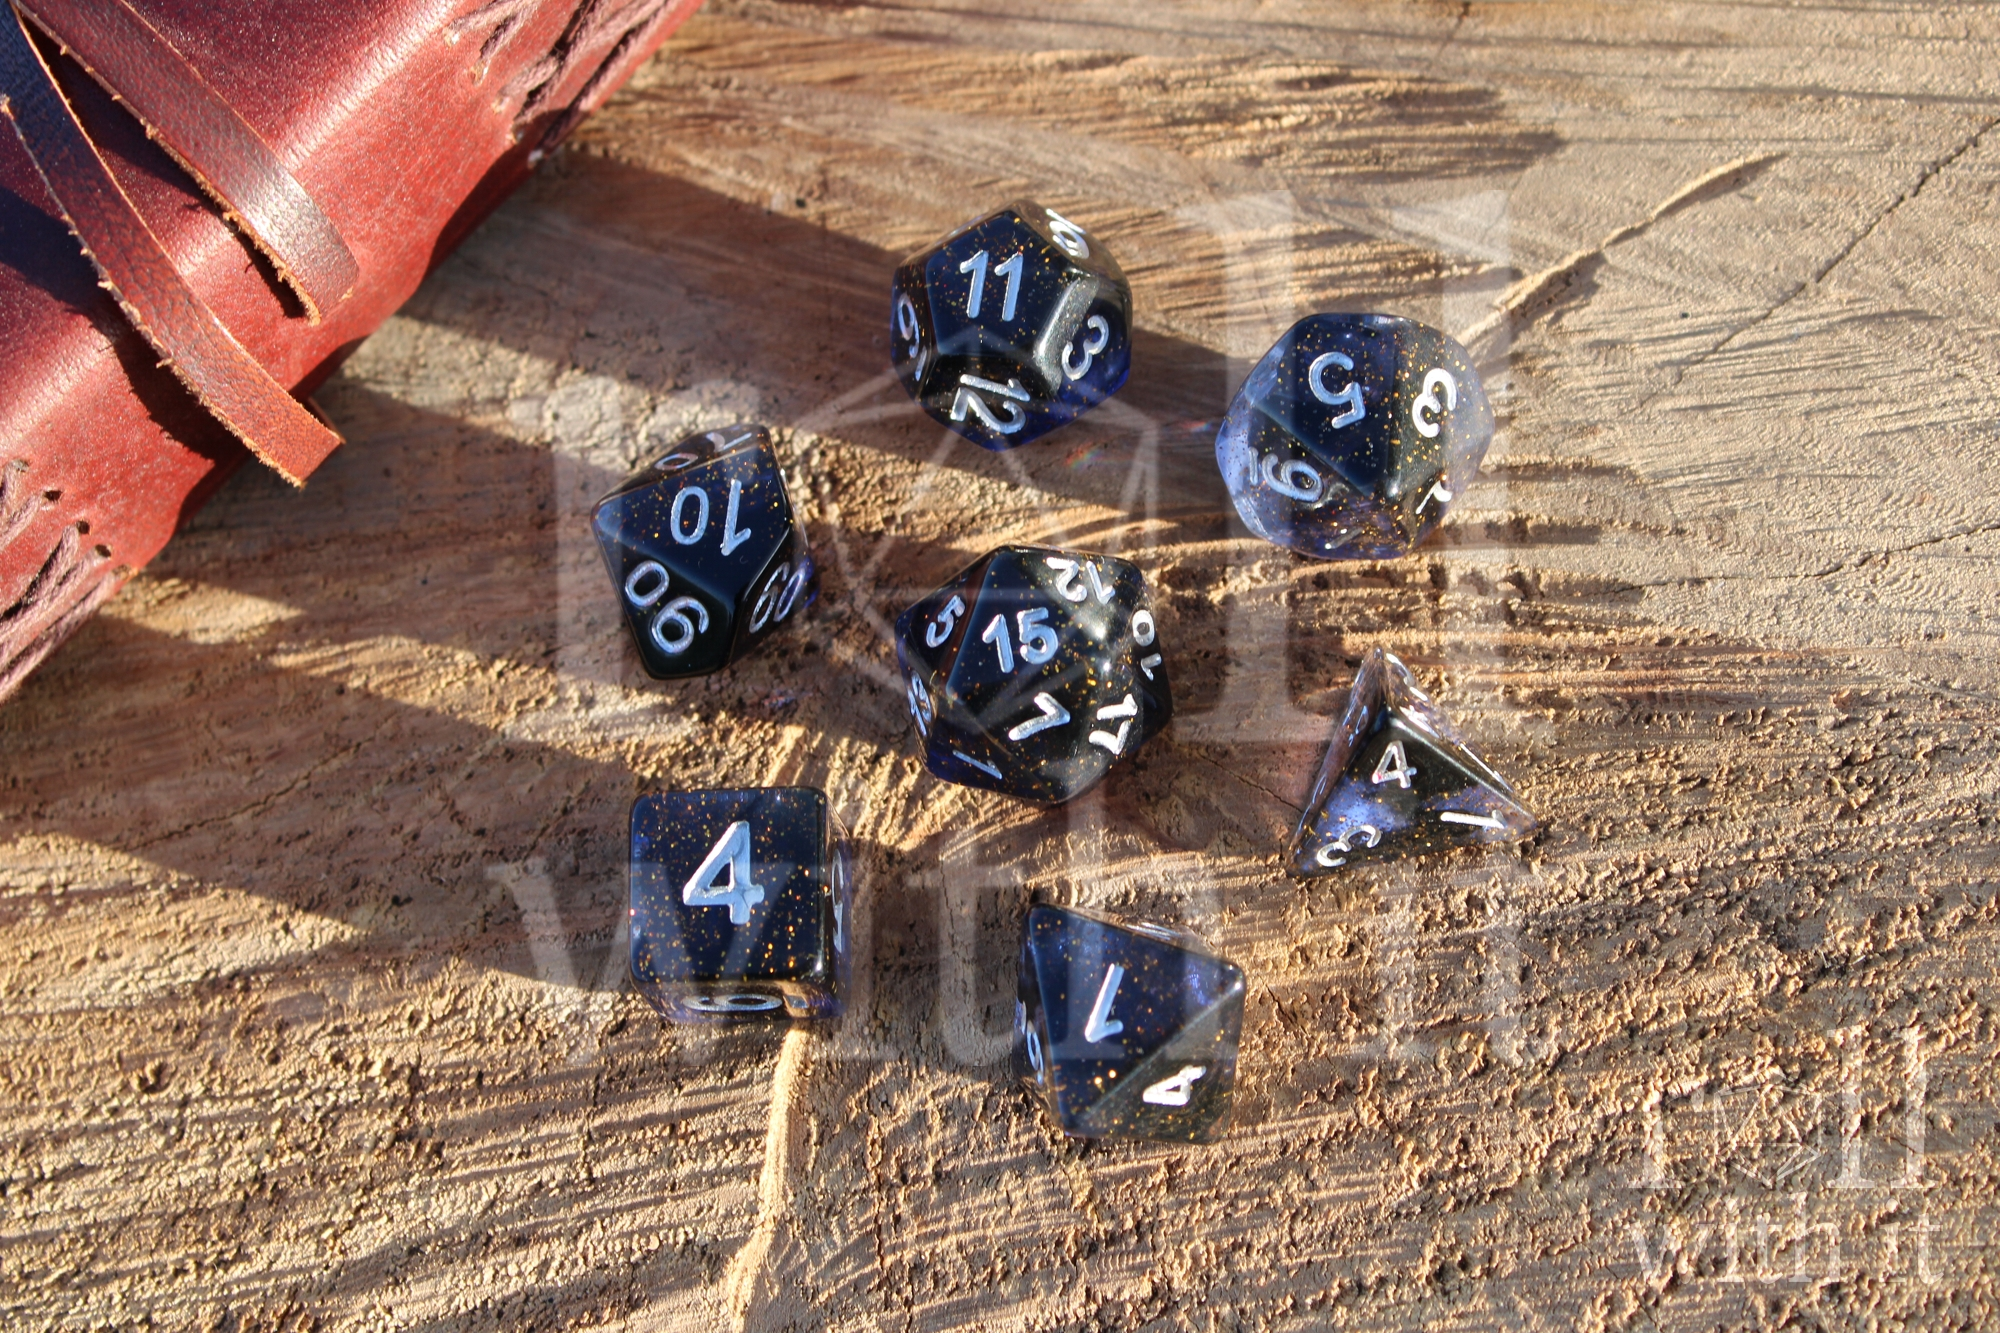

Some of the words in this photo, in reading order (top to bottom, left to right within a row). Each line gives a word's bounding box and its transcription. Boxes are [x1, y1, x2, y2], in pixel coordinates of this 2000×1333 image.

[960, 250, 1024, 322] 11
[1061, 314, 1110, 381] 3
[950, 373, 1031, 434] 12
[1308, 351, 1366, 429] 5
[1411, 367, 1457, 438] 3
[670, 478, 752, 556] 10
[1046, 556, 1116, 605] 12
[925, 593, 966, 649] 5
[982, 606, 1059, 673] 15
[1088, 692, 1139, 756] 17
[1371, 739, 1418, 789] 4
[1316, 825, 1383, 868] 3
[1440, 809, 1507, 830] 1
[683, 820, 765, 925] 4
[1142, 1065, 1207, 1107] 4
